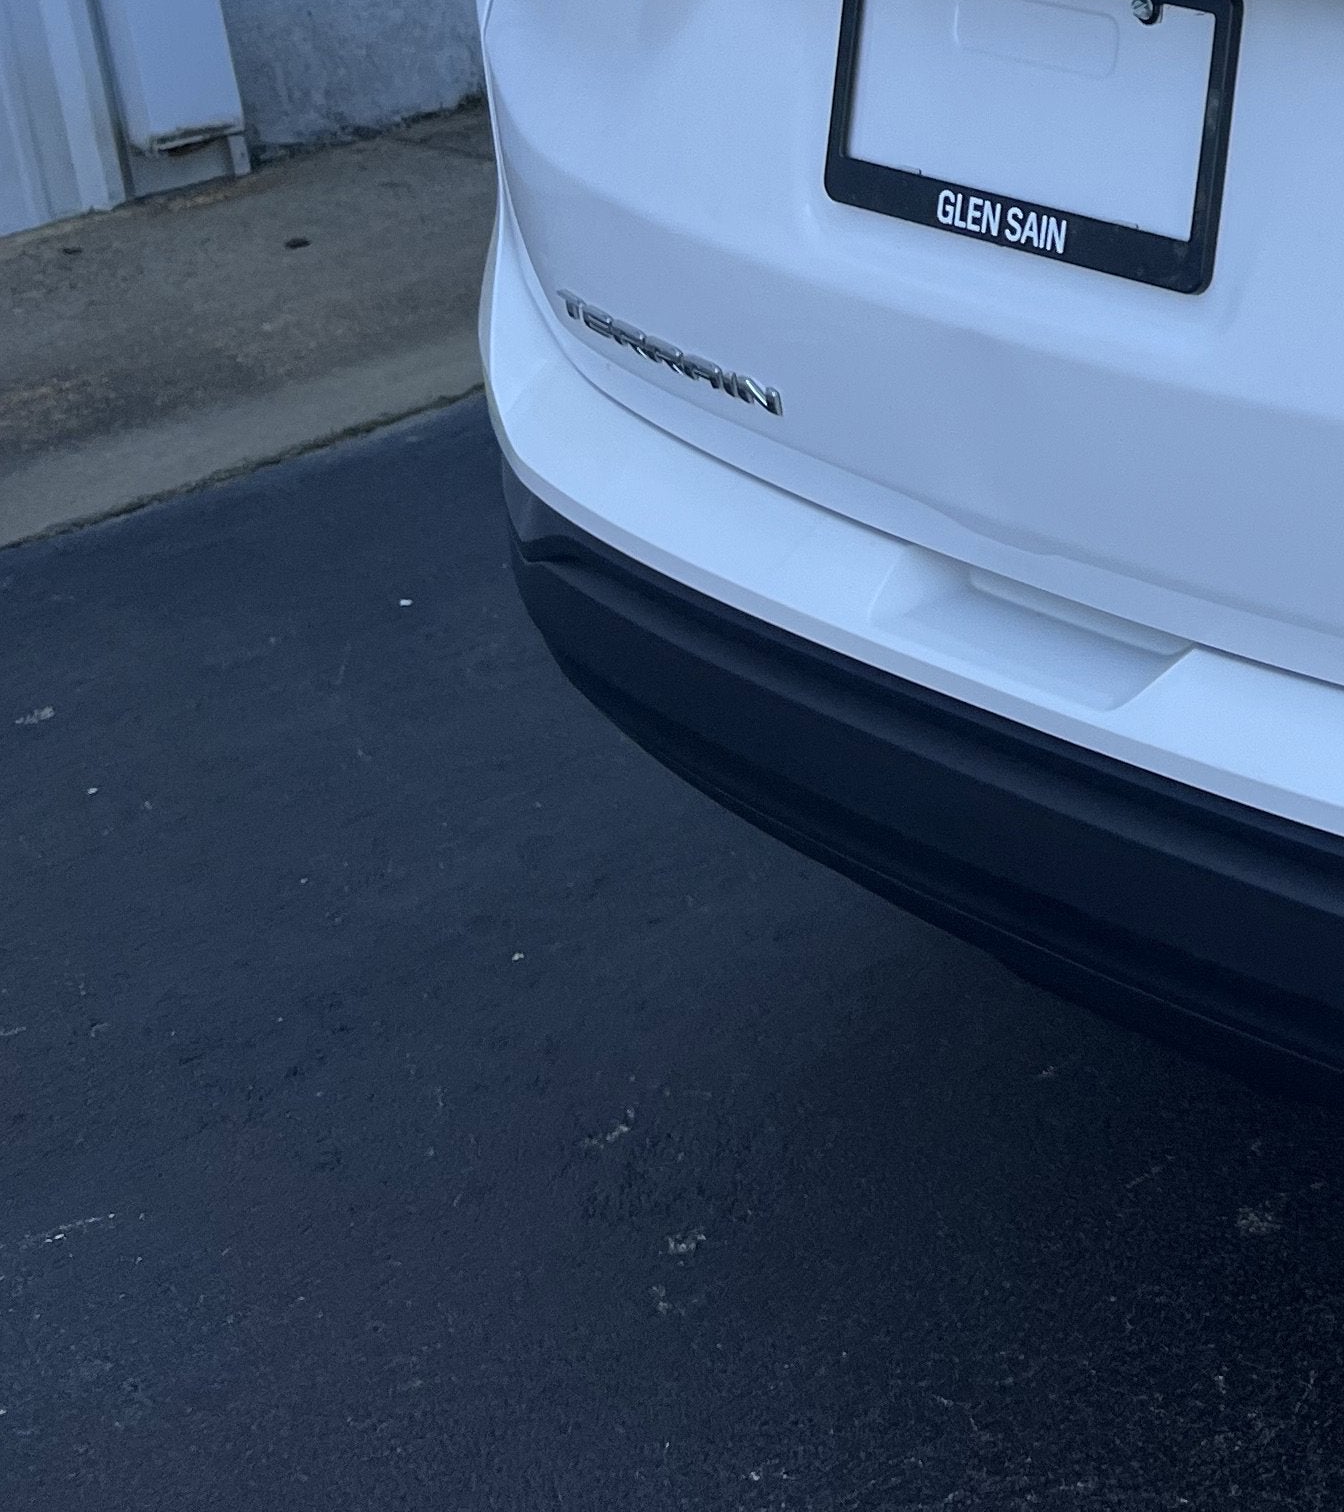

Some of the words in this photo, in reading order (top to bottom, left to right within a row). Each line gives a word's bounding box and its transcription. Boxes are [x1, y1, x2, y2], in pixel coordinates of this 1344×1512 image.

[936, 189, 1001, 238] GLEN
[1005, 206, 1067, 255] SAIN
[556, 287, 784, 418] TERRAIN
